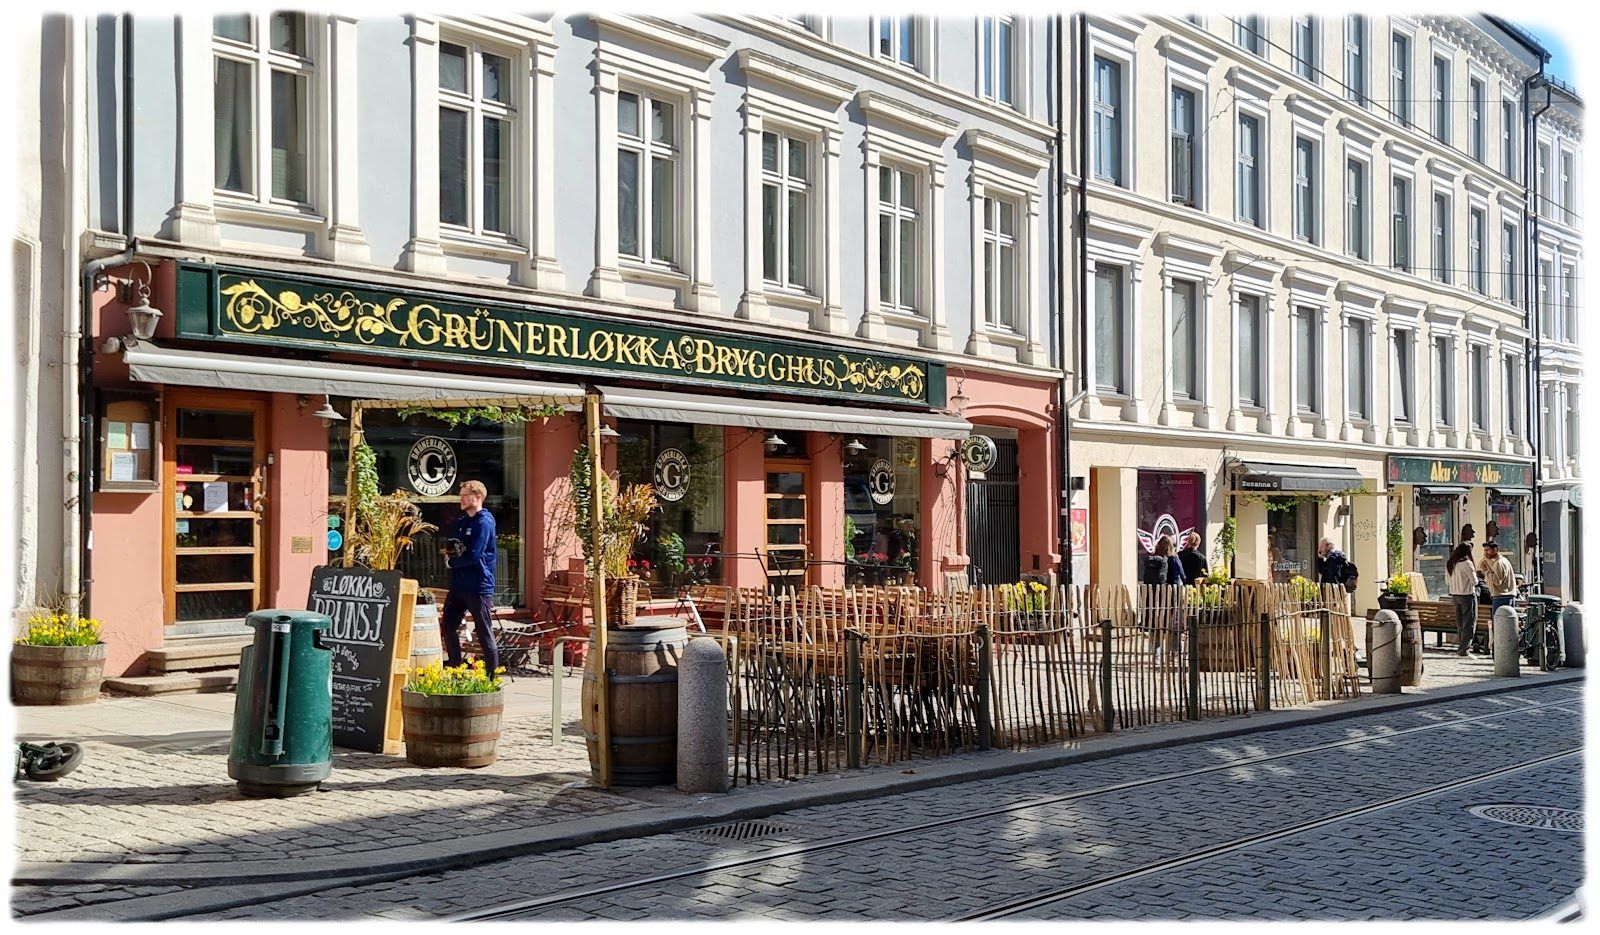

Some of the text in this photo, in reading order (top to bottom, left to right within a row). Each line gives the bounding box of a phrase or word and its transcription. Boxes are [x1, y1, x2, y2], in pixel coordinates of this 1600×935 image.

[407, 303, 836, 387] GRÜNERLØKKA BRYGGHUS
[967, 445, 983, 464] G
[419, 452, 445, 482] G
[662, 462, 681, 488] G
[1430, 461, 1451, 482] Aku
[1481, 464, 1500, 484] Aku
[875, 471, 889, 493] G
[1241, 480, 1271, 488] Zuzanna
[331, 575, 373, 598] LØKKA
